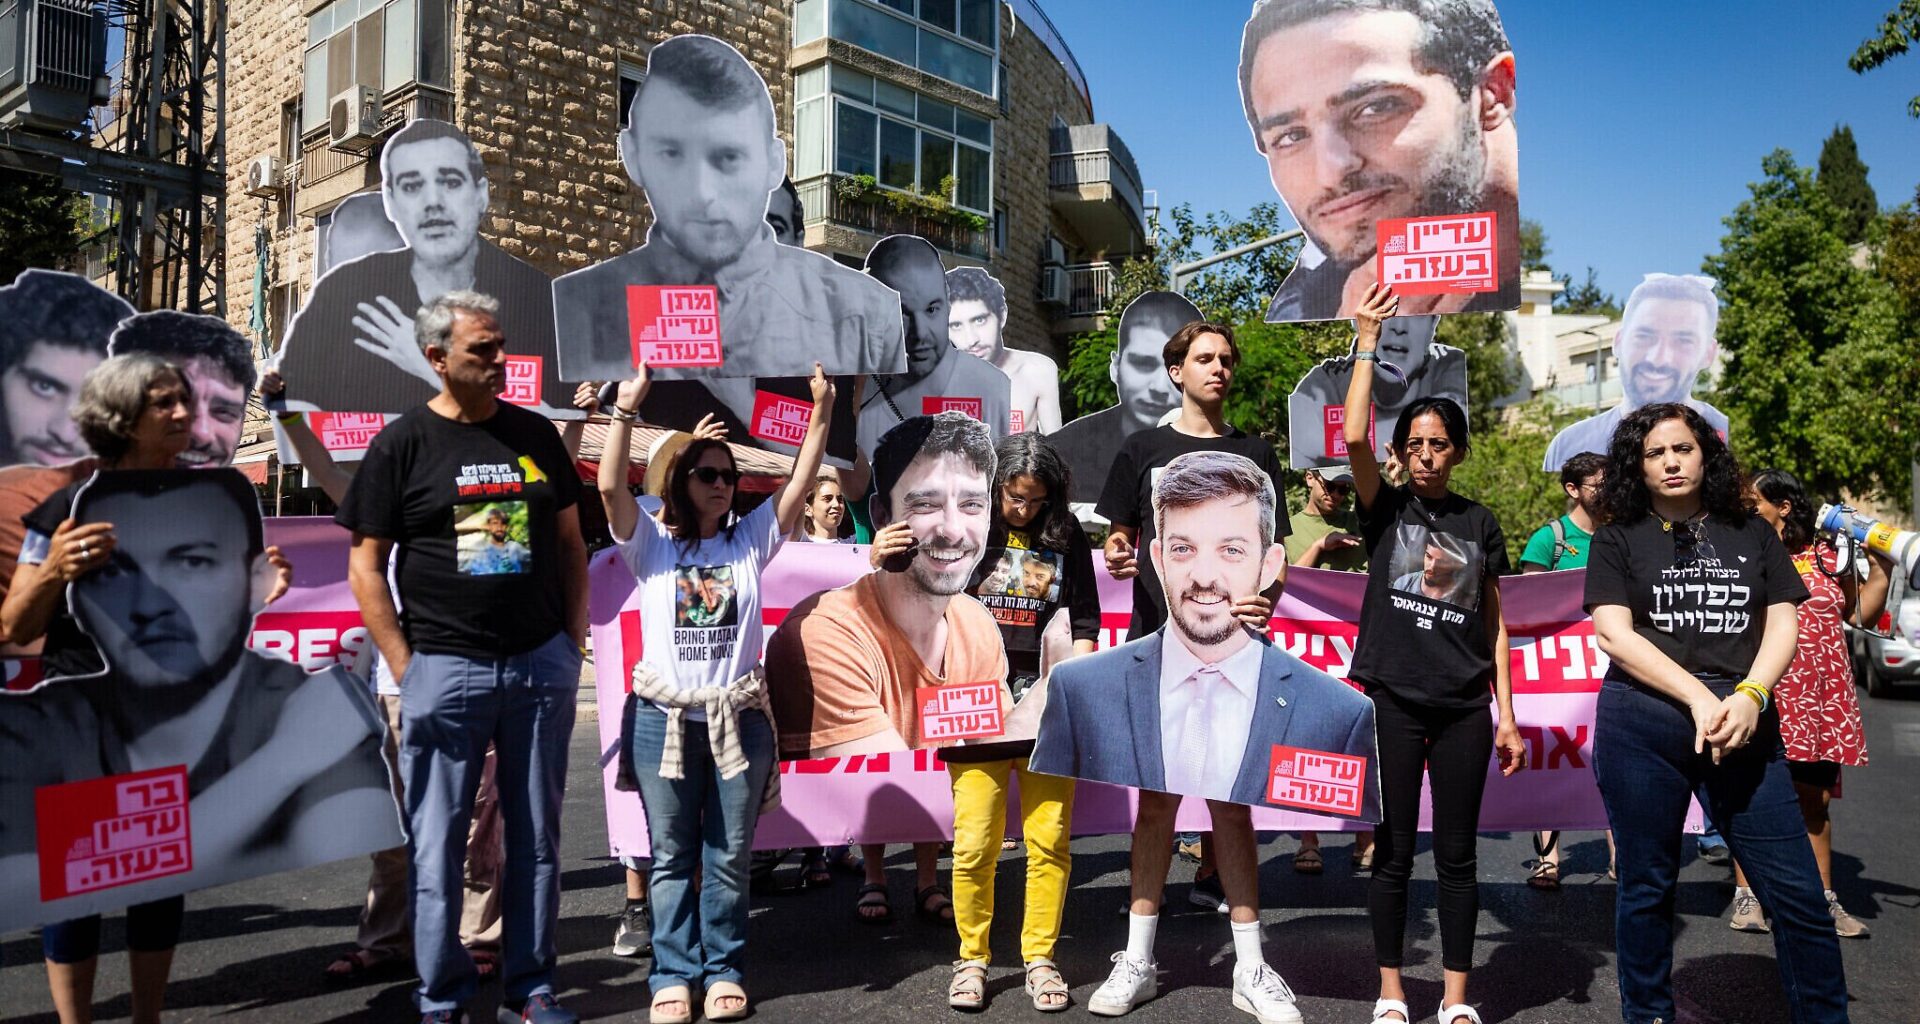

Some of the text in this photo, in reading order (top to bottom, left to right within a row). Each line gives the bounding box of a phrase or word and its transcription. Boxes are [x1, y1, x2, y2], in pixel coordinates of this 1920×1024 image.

[1413, 221, 1487, 251] עדיין
[1395, 254, 1489, 280] בעזה.
[667, 293, 712, 313] מתן
[661, 318, 713, 337] עדיין
[650, 343, 717, 360] בעזה.
[766, 422, 807, 440] עזה.
[1661, 565, 1740, 579] מצוה גדולה
[1391, 595, 1465, 624] מתן צנגאוקר
[1652, 582, 1750, 614] כפדיון
[1416, 617, 1433, 630] 25
[1649, 610, 1750, 633] שבויים
[675, 628, 738, 645] BRING MATAN
[679, 644, 734, 661] HOME NOW!
[943, 688, 994, 712] עדיין
[932, 713, 998, 735] בעזה.
[1298, 756, 1358, 780] עדיין
[126, 780, 179, 808] בר
[1281, 781, 1354, 808] בעזה.
[101, 810, 181, 850] עדיין
[81, 843, 184, 885] בעזה.
